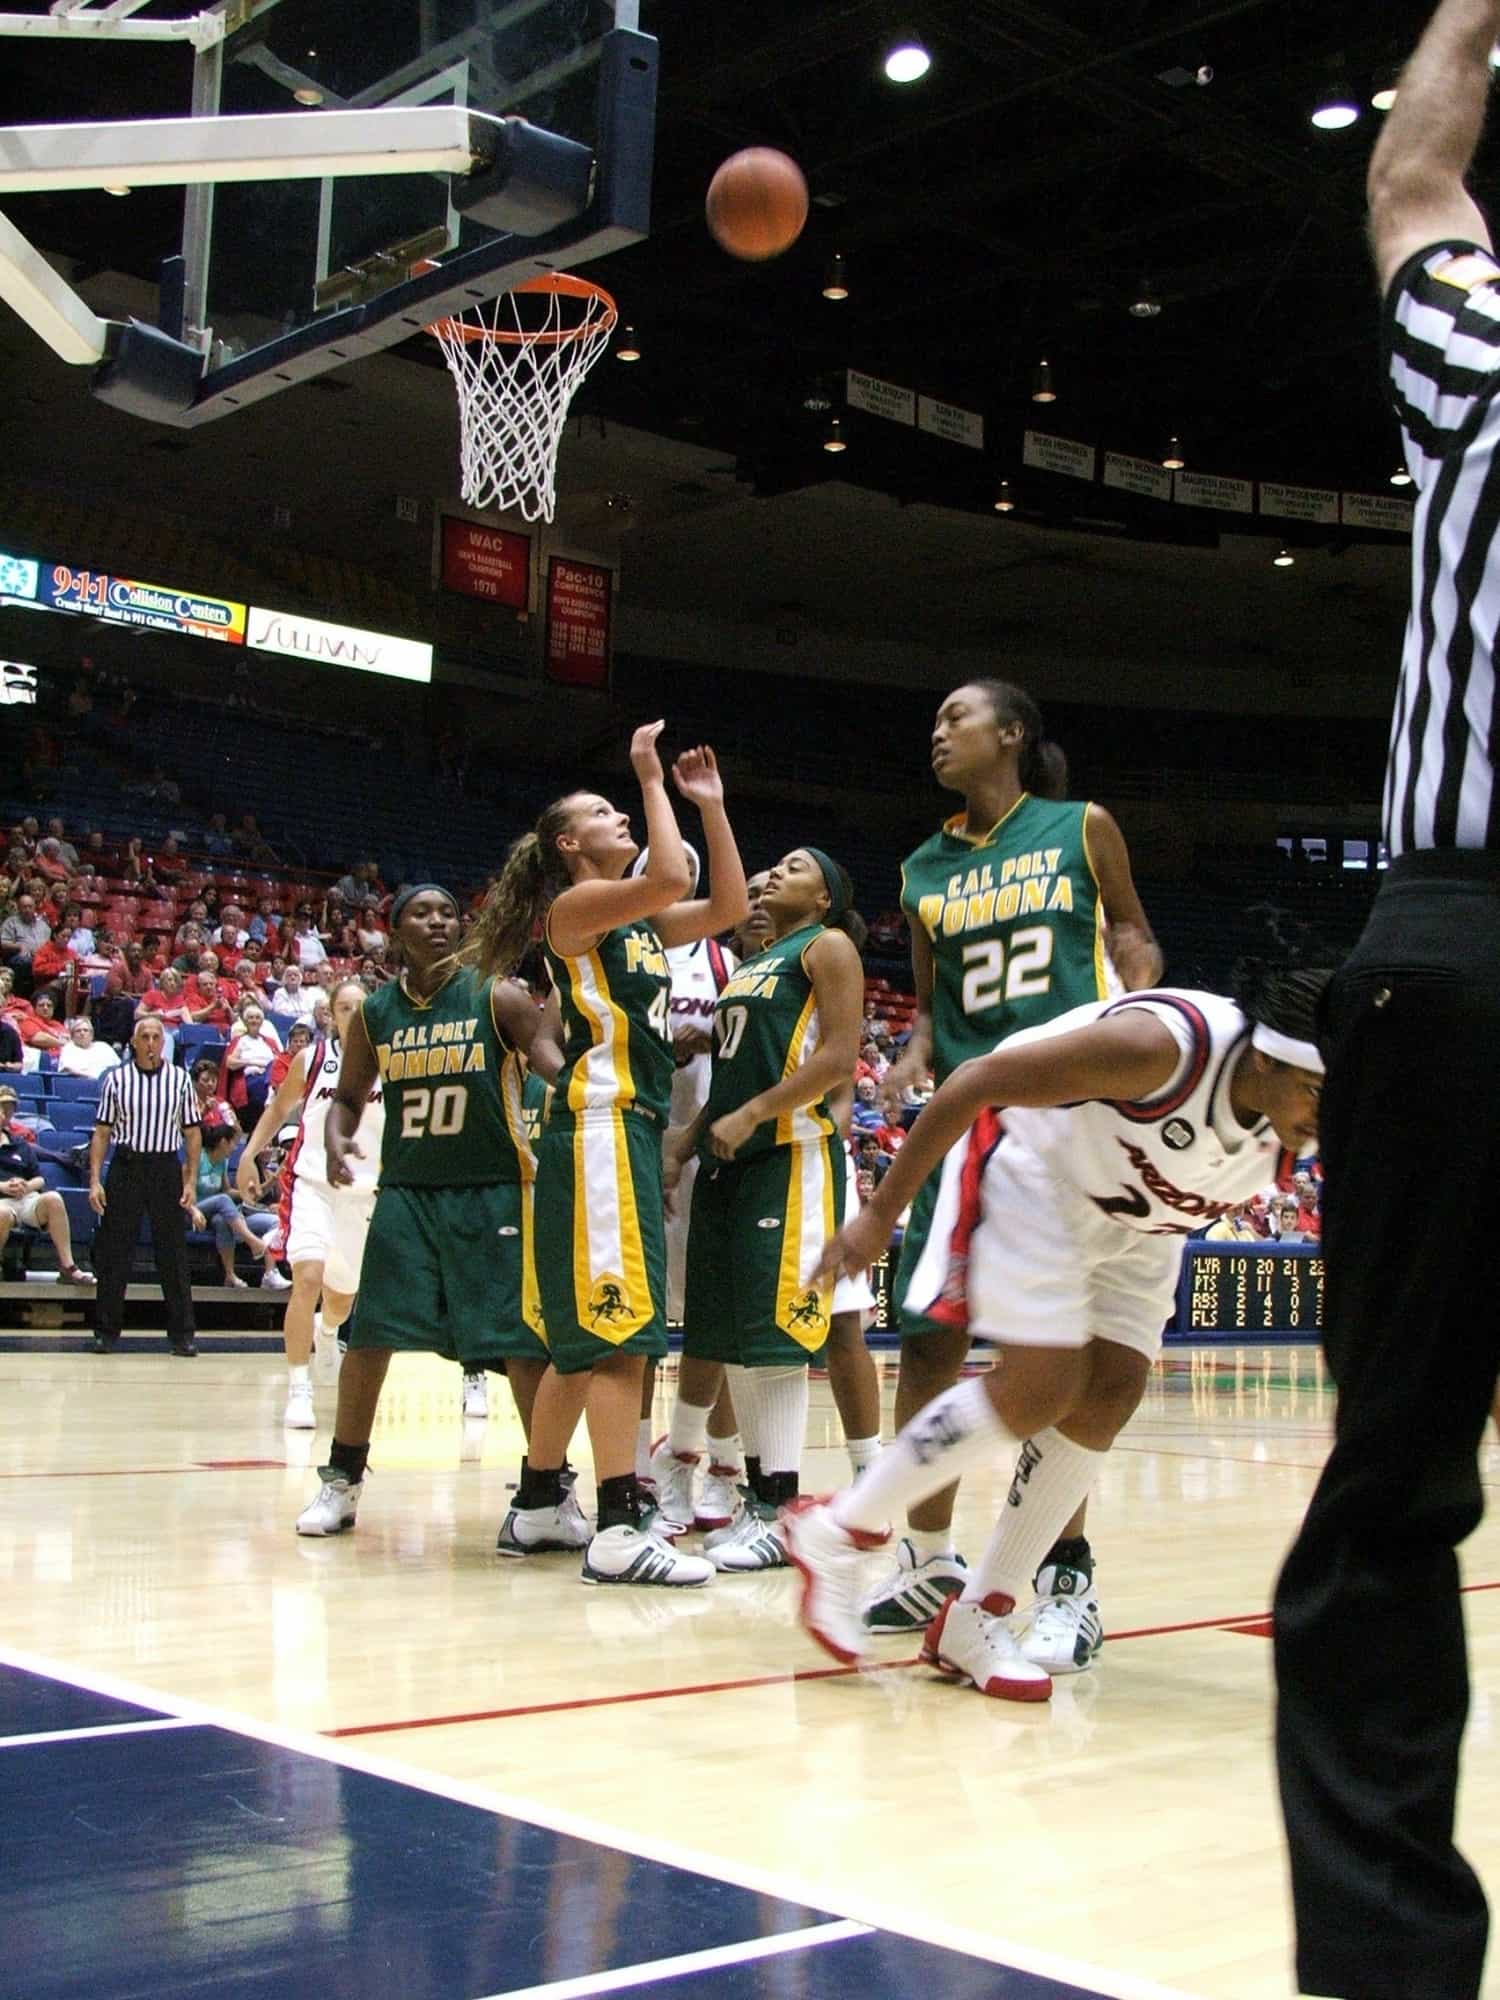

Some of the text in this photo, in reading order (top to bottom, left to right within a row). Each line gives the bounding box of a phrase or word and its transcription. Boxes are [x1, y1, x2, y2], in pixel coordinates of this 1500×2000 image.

[470, 531, 503, 551] WAC
[112, 580, 173, 613] Collision
[174, 595, 229, 626] Centers
[946, 848, 1062, 899] CAL POLY
[918, 875, 1073, 943] POMONA
[962, 925, 1053, 1015] 22
[392, 1018, 478, 1049] CAL POLY
[376, 1043, 486, 1083] POMONA
[401, 1085, 468, 1138] 20
[1195, 1275, 1325, 1292] PTS 2 11 3 4
[1230, 1258, 1247, 1274] 10
[1256, 1259, 1274, 1275] 20
[1283, 1260, 1297, 1275] 21
[1309, 1259, 1325, 1276] 22
[1192, 1292, 1218, 1309] RBS
[1236, 1292, 1246, 1309] 2
[1263, 1294, 1273, 1309] 4
[1290, 1294, 1300, 1309] 0
[1192, 1310, 1218, 1327] FLS
[1236, 1310, 1246, 1327] 2
[1263, 1310, 1273, 1327] 2
[1290, 1311, 1299, 1327] 0
